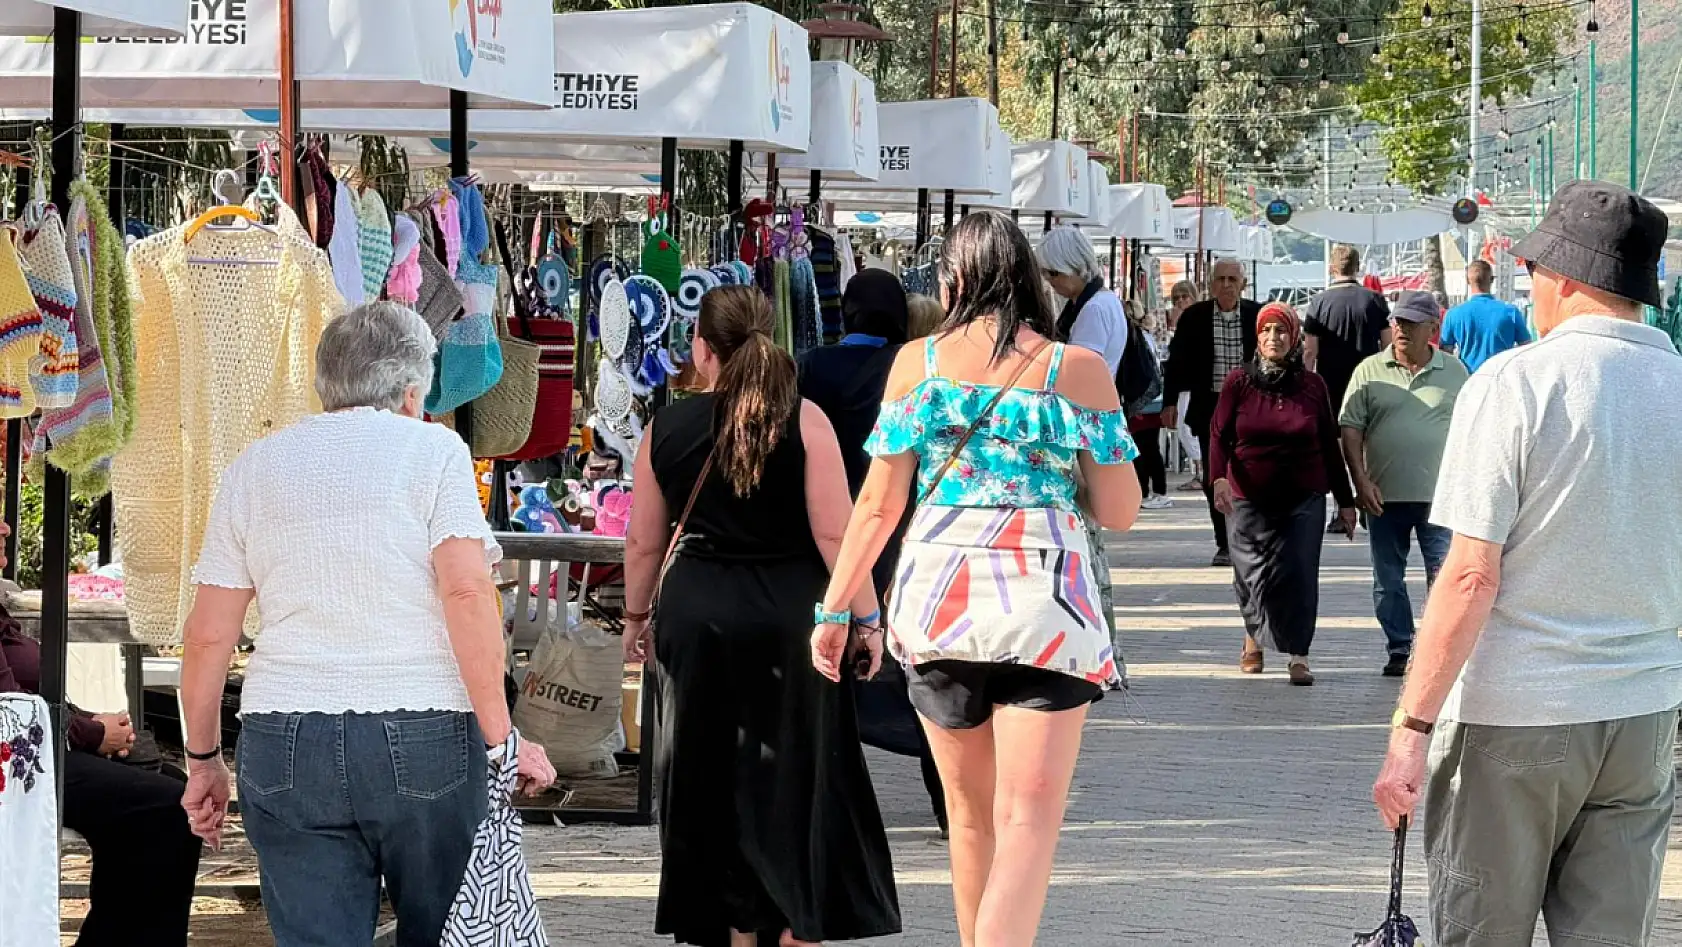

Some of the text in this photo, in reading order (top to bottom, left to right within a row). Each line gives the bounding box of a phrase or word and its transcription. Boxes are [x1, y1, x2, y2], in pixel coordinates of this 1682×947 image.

[191, 0, 246, 21] iYE
[553, 73, 638, 91] THiYE
[553, 93, 638, 110] EDiYESi
[880, 145, 910, 158] iYE
[880, 159, 910, 171] YESi
